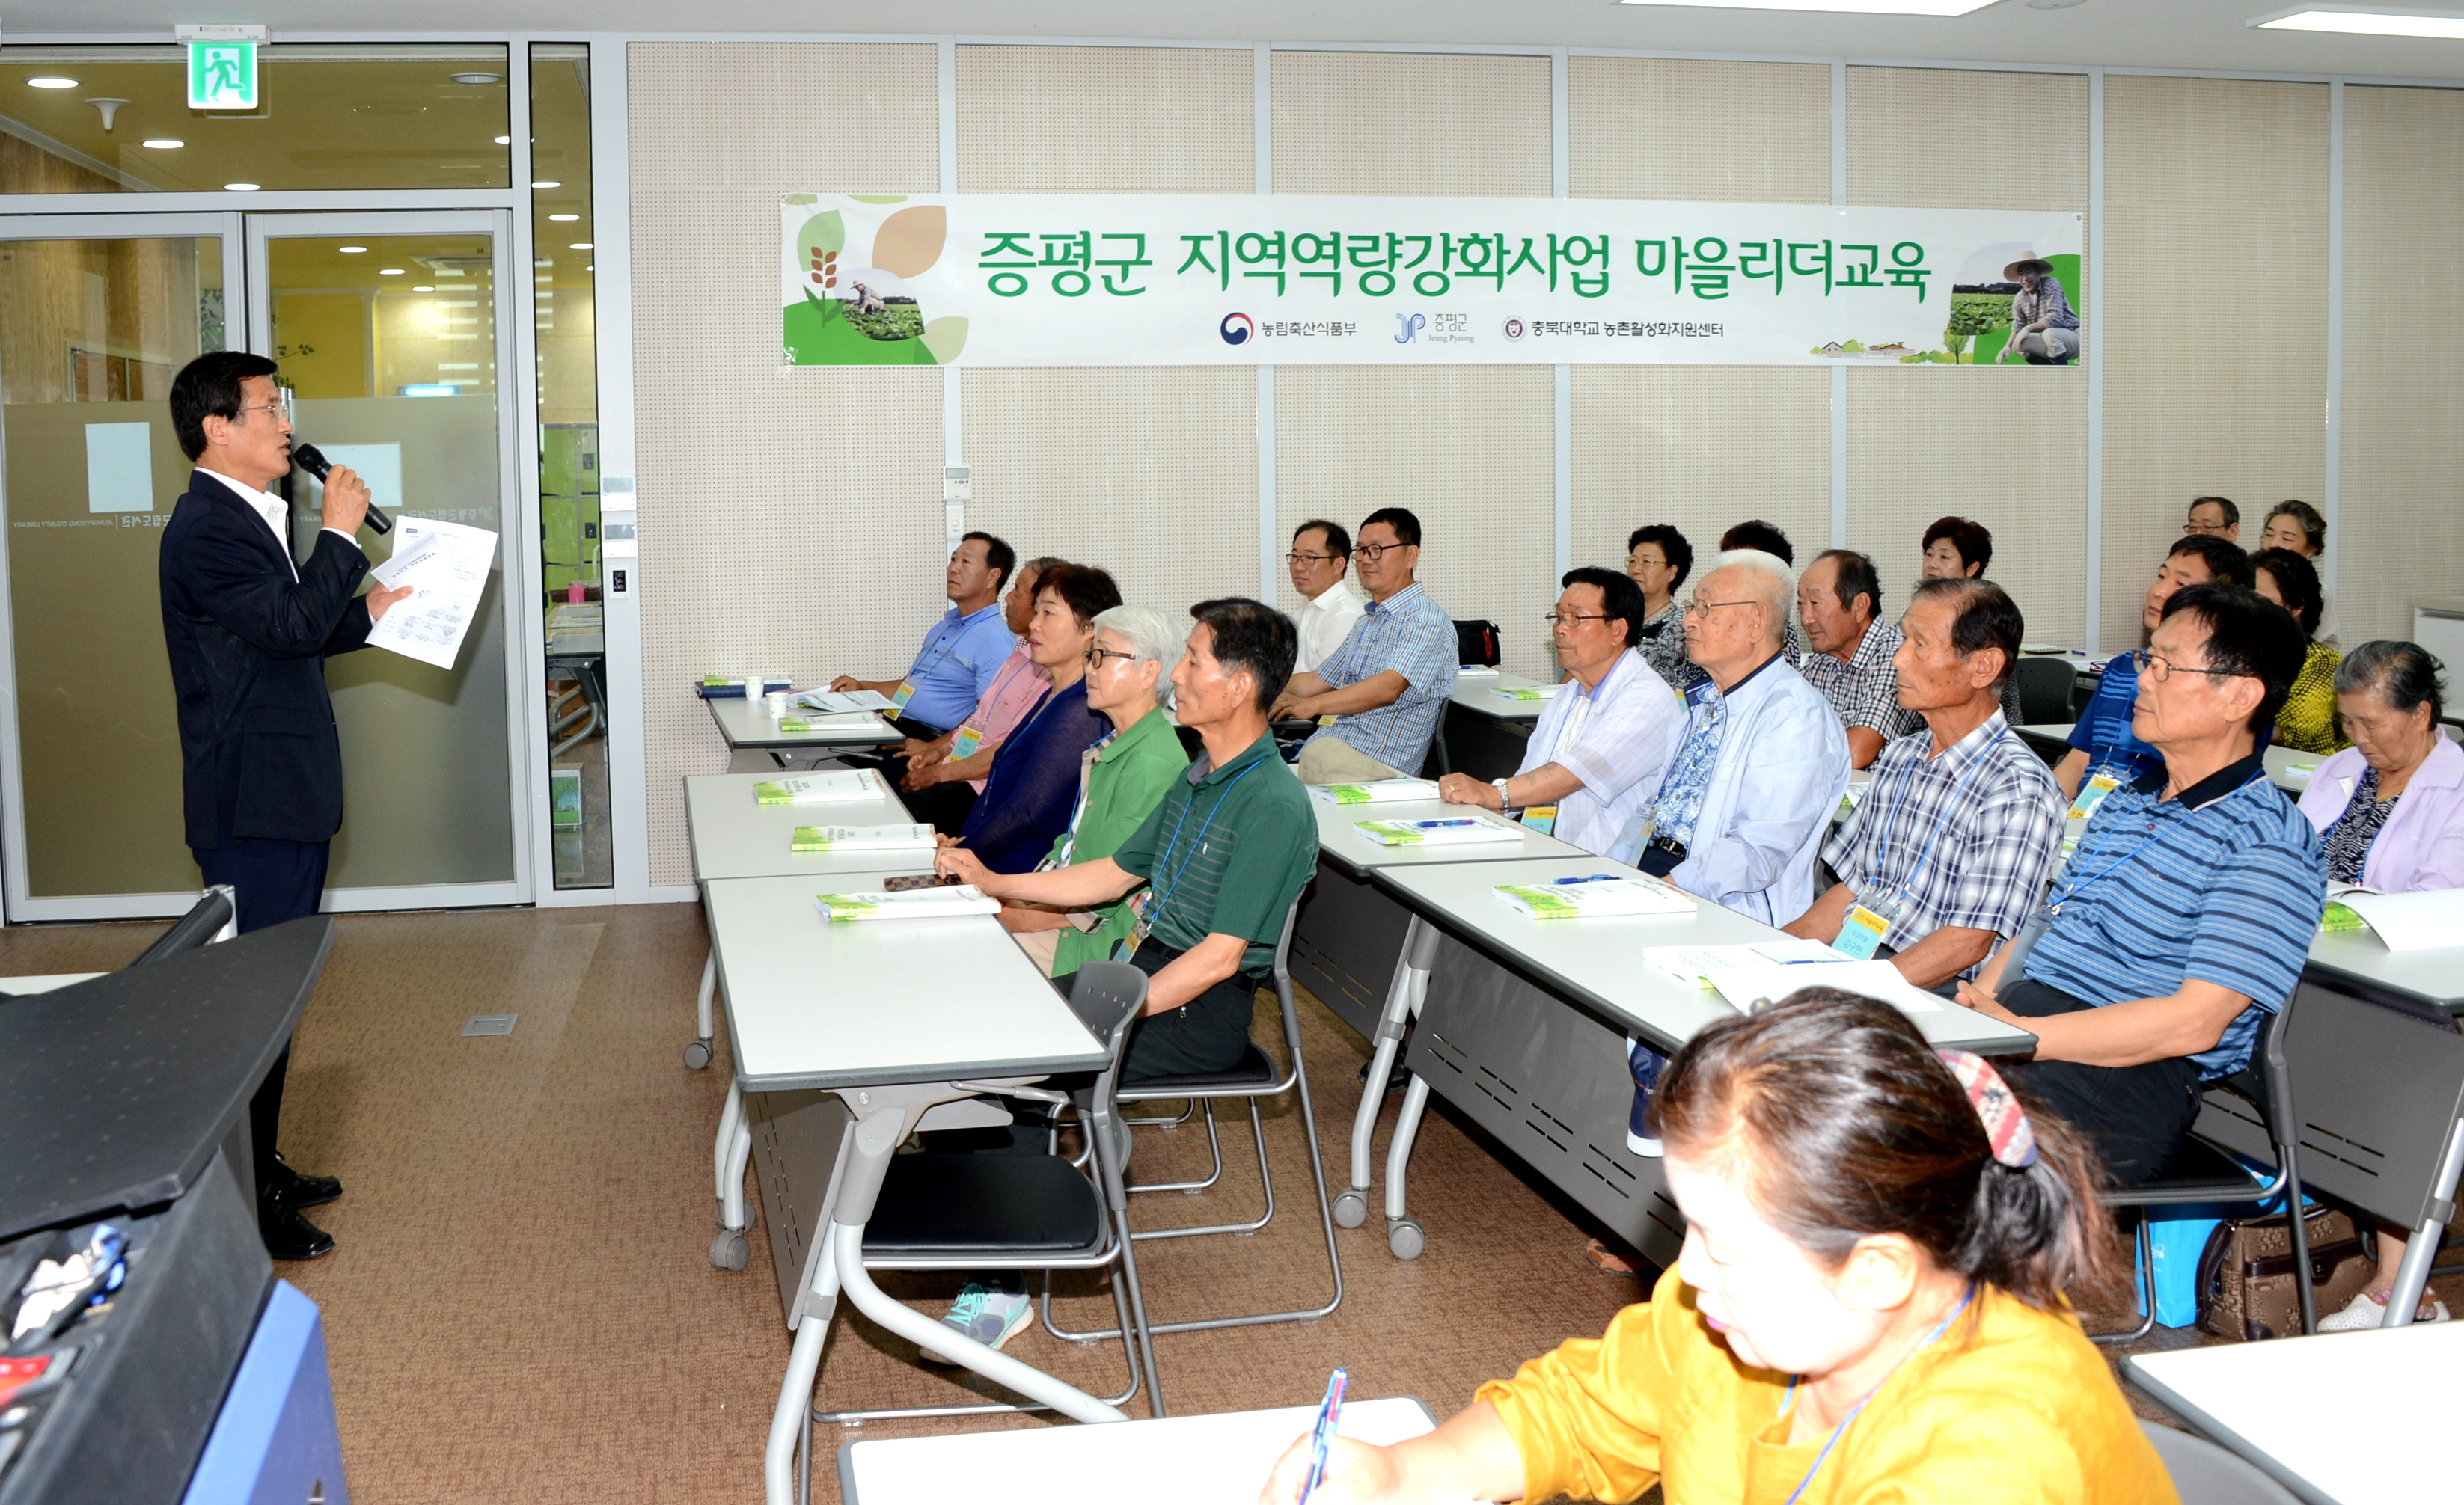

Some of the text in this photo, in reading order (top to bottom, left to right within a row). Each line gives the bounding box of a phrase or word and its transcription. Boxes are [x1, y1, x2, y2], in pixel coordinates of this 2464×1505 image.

[979, 231, 1931, 302] 증평군 지역역량강화사업 마을리더교육
[1262, 322, 1357, 337] 농림축산식품부
[1434, 313, 1467, 332] 증평군
[1532, 320, 1724, 337] 충북대학교 농촌활성화지원센터
[1428, 334, 1475, 343] Jeung Pyeong
